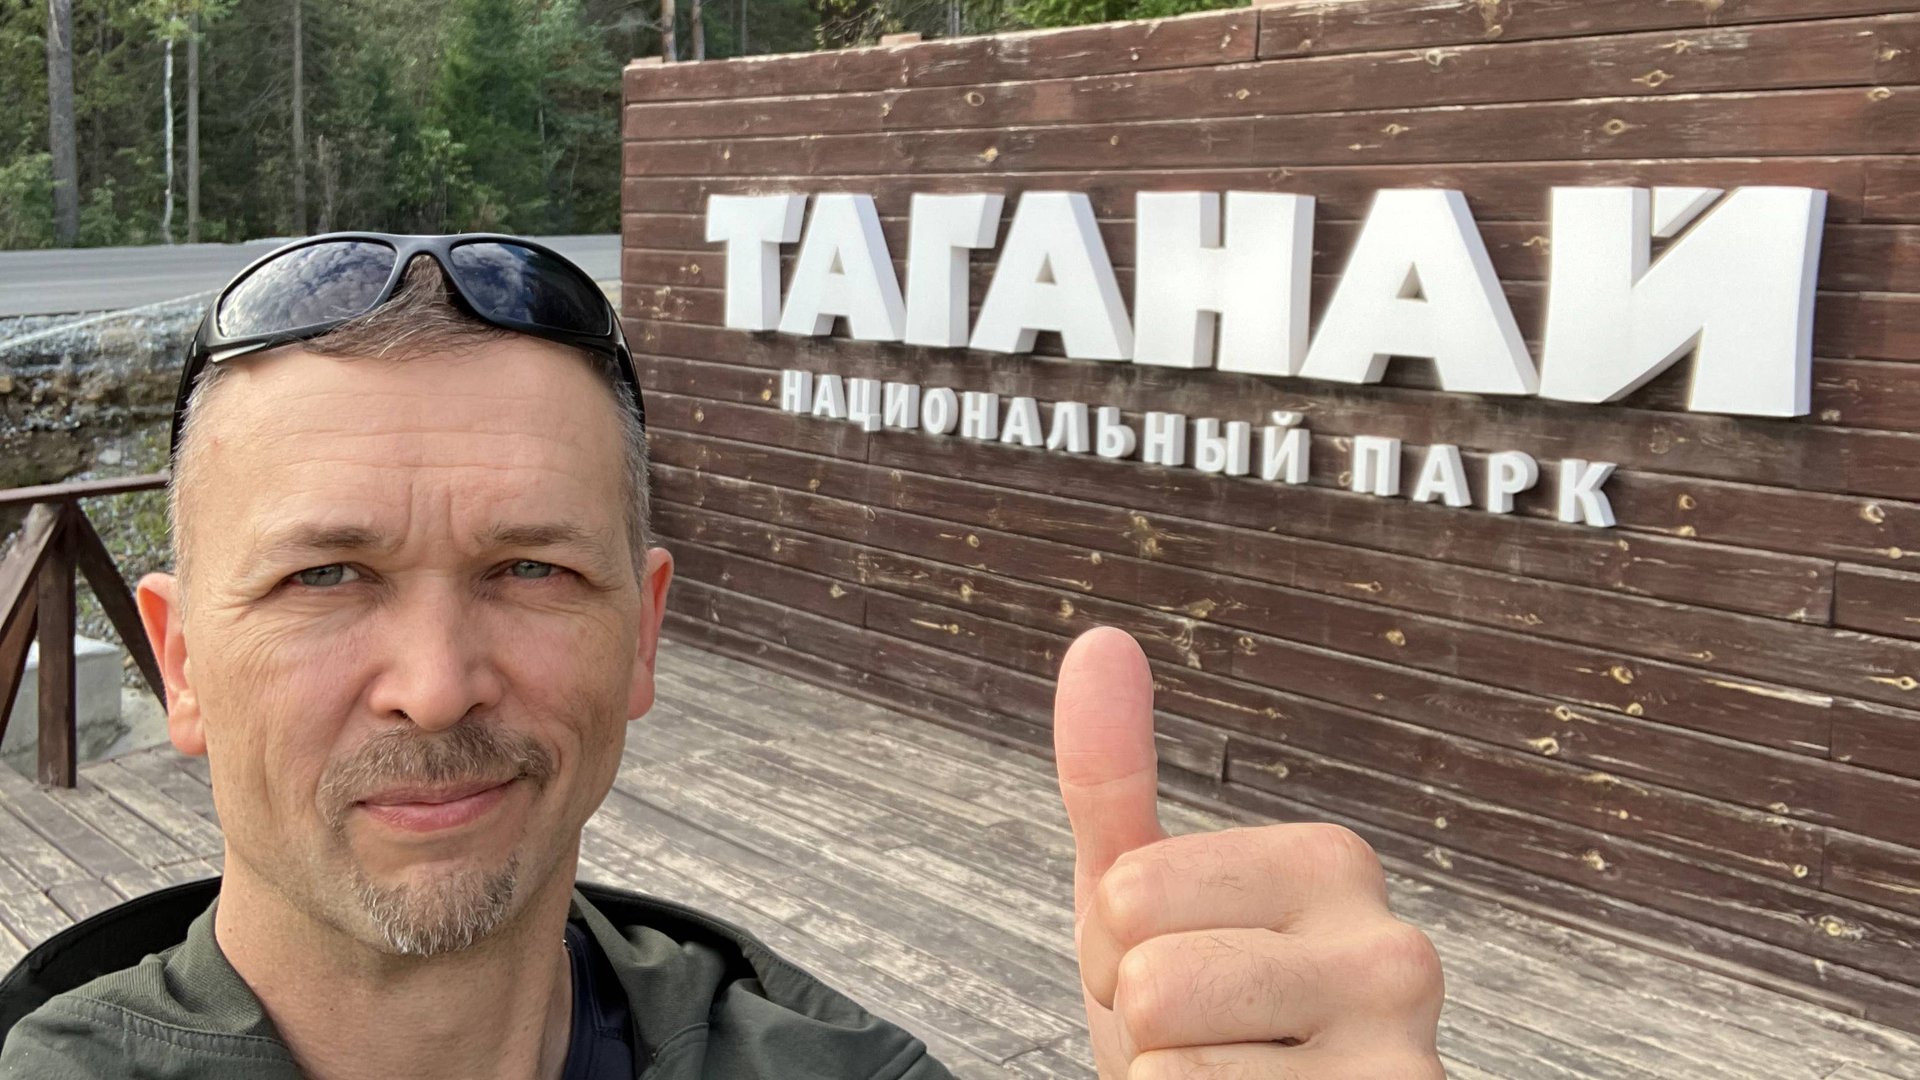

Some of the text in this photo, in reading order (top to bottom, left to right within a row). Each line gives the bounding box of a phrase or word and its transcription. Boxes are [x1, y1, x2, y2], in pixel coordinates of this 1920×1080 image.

[706, 186, 1828, 417] ТАГАНАЙ
[781, 369, 1618, 528] НАЦИОНАЛЬНЫЙ ПАРК
